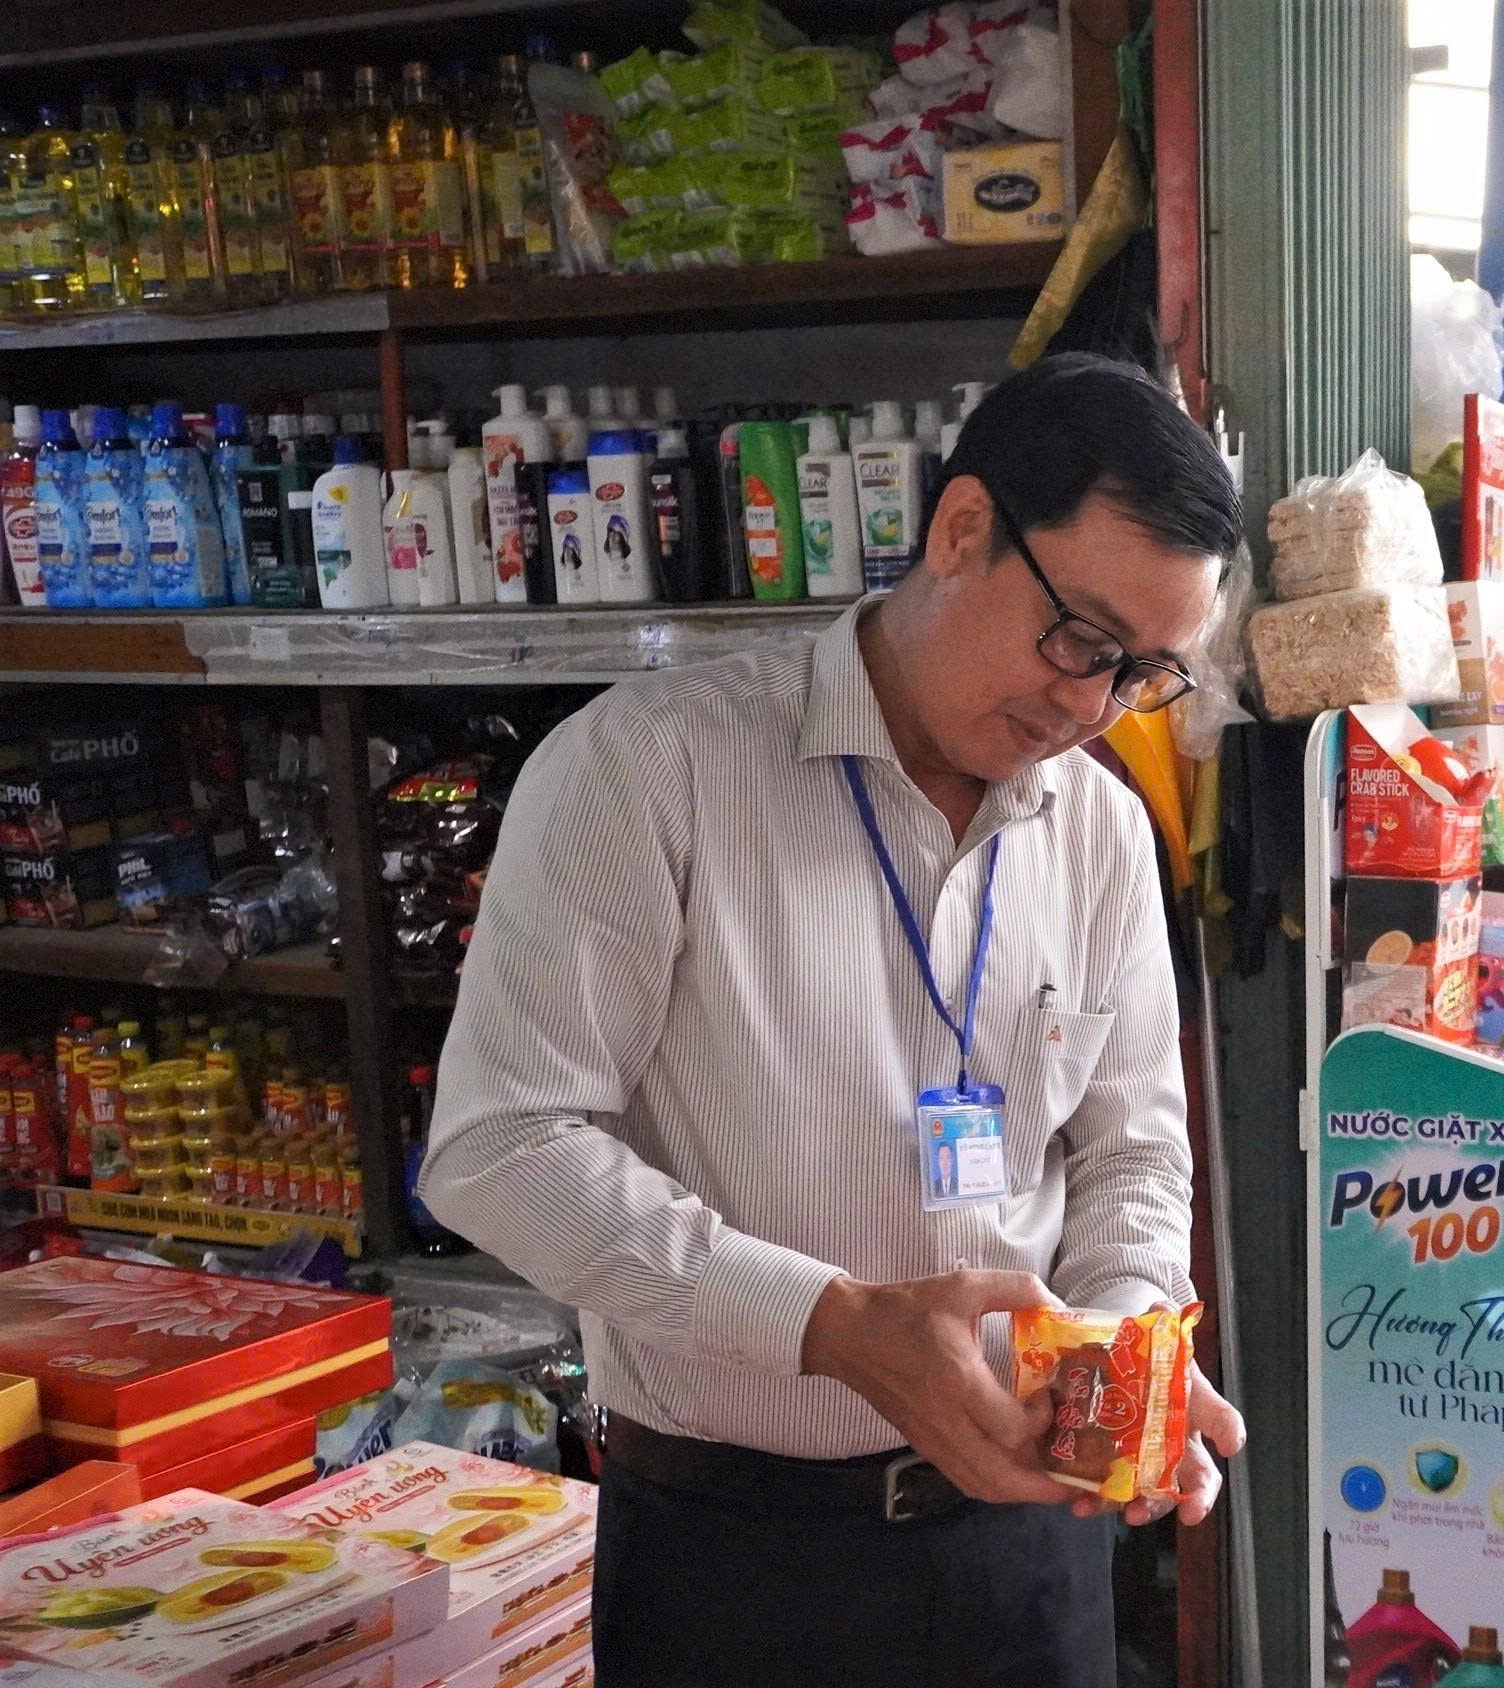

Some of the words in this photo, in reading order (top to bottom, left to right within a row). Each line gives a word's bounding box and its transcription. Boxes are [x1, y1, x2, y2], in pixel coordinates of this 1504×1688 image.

[860, 463, 900, 478] CLEAR
[1350, 768, 1401, 783] FLAVORED
[1350, 781, 1377, 796] CRAB
[1378, 783, 1410, 797] STICK
[1330, 1112, 1409, 1137] NƯỚC
[1417, 1115, 1481, 1145] GIẶT
[1407, 1206, 1500, 1264] 100
[1326, 1284, 1457, 1357] Hương
[1369, 1356, 1425, 1387] mê
